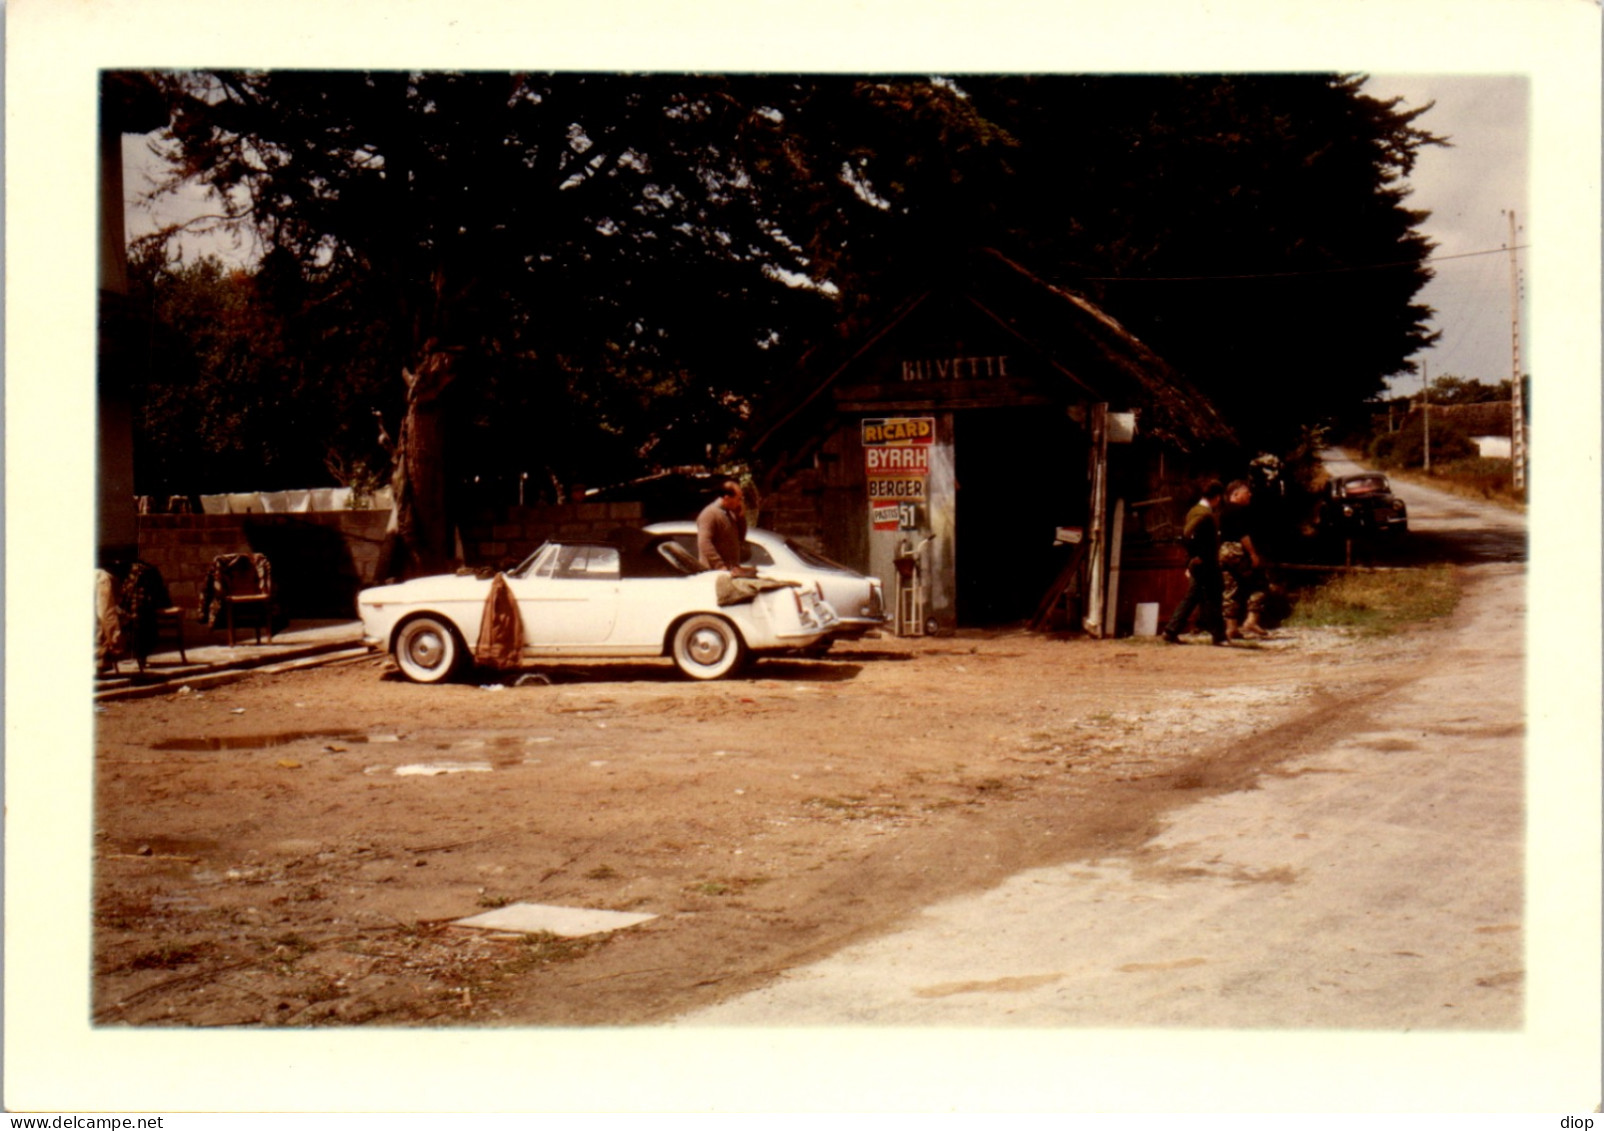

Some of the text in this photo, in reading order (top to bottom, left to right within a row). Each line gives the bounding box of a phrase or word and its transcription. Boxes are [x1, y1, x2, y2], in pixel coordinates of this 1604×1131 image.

[902, 355, 1008, 381] BUVETTE
[865, 421, 930, 441] RICARD
[867, 448, 927, 468] BYRRH
[869, 480, 923, 496] BERGER
[874, 505, 915, 527] PASTIS 51
